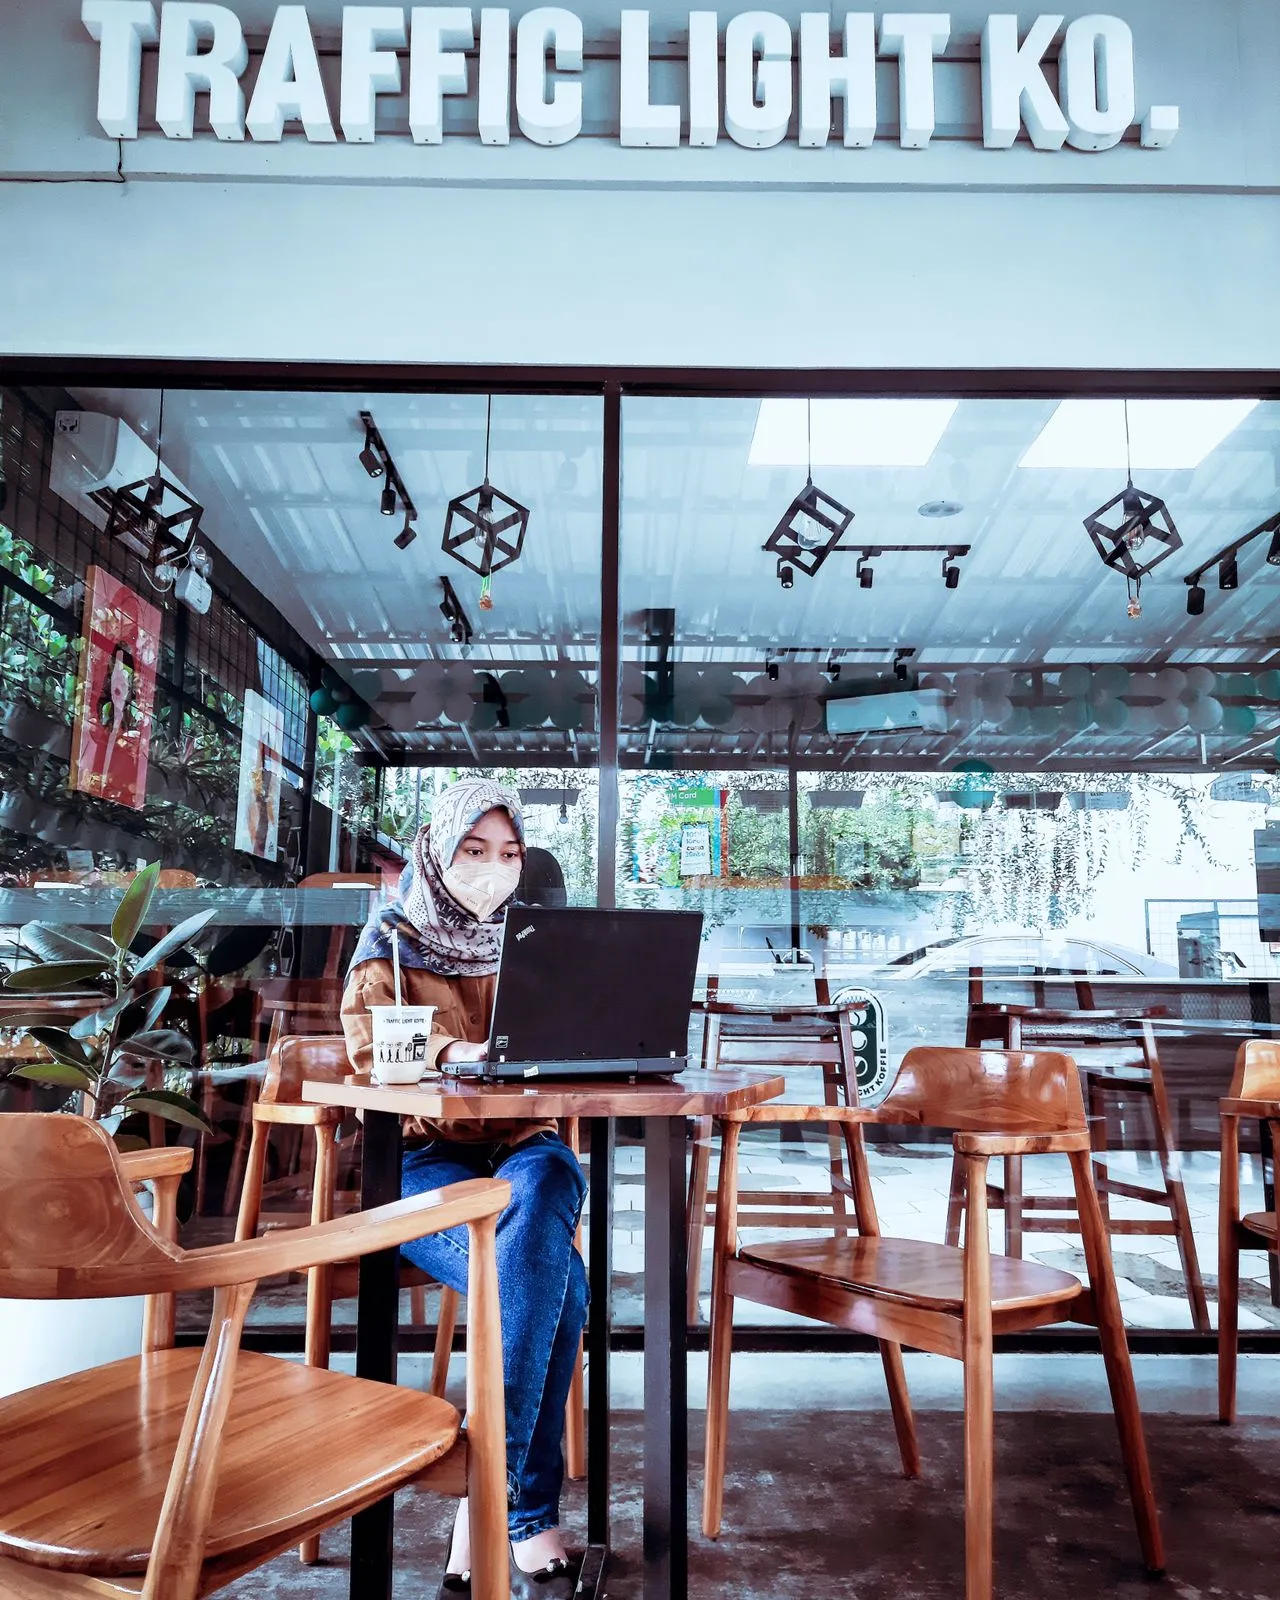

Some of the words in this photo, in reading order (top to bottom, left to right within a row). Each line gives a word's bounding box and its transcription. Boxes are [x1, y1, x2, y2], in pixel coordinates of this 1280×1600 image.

[81, 0, 583, 146] TRAFFIC
[620, 9, 950, 149] LIGHT
[981, 13, 1179, 151] KO.
[678, 791, 697, 800] Card
[875, 1048, 887, 1086] KOFFIE
